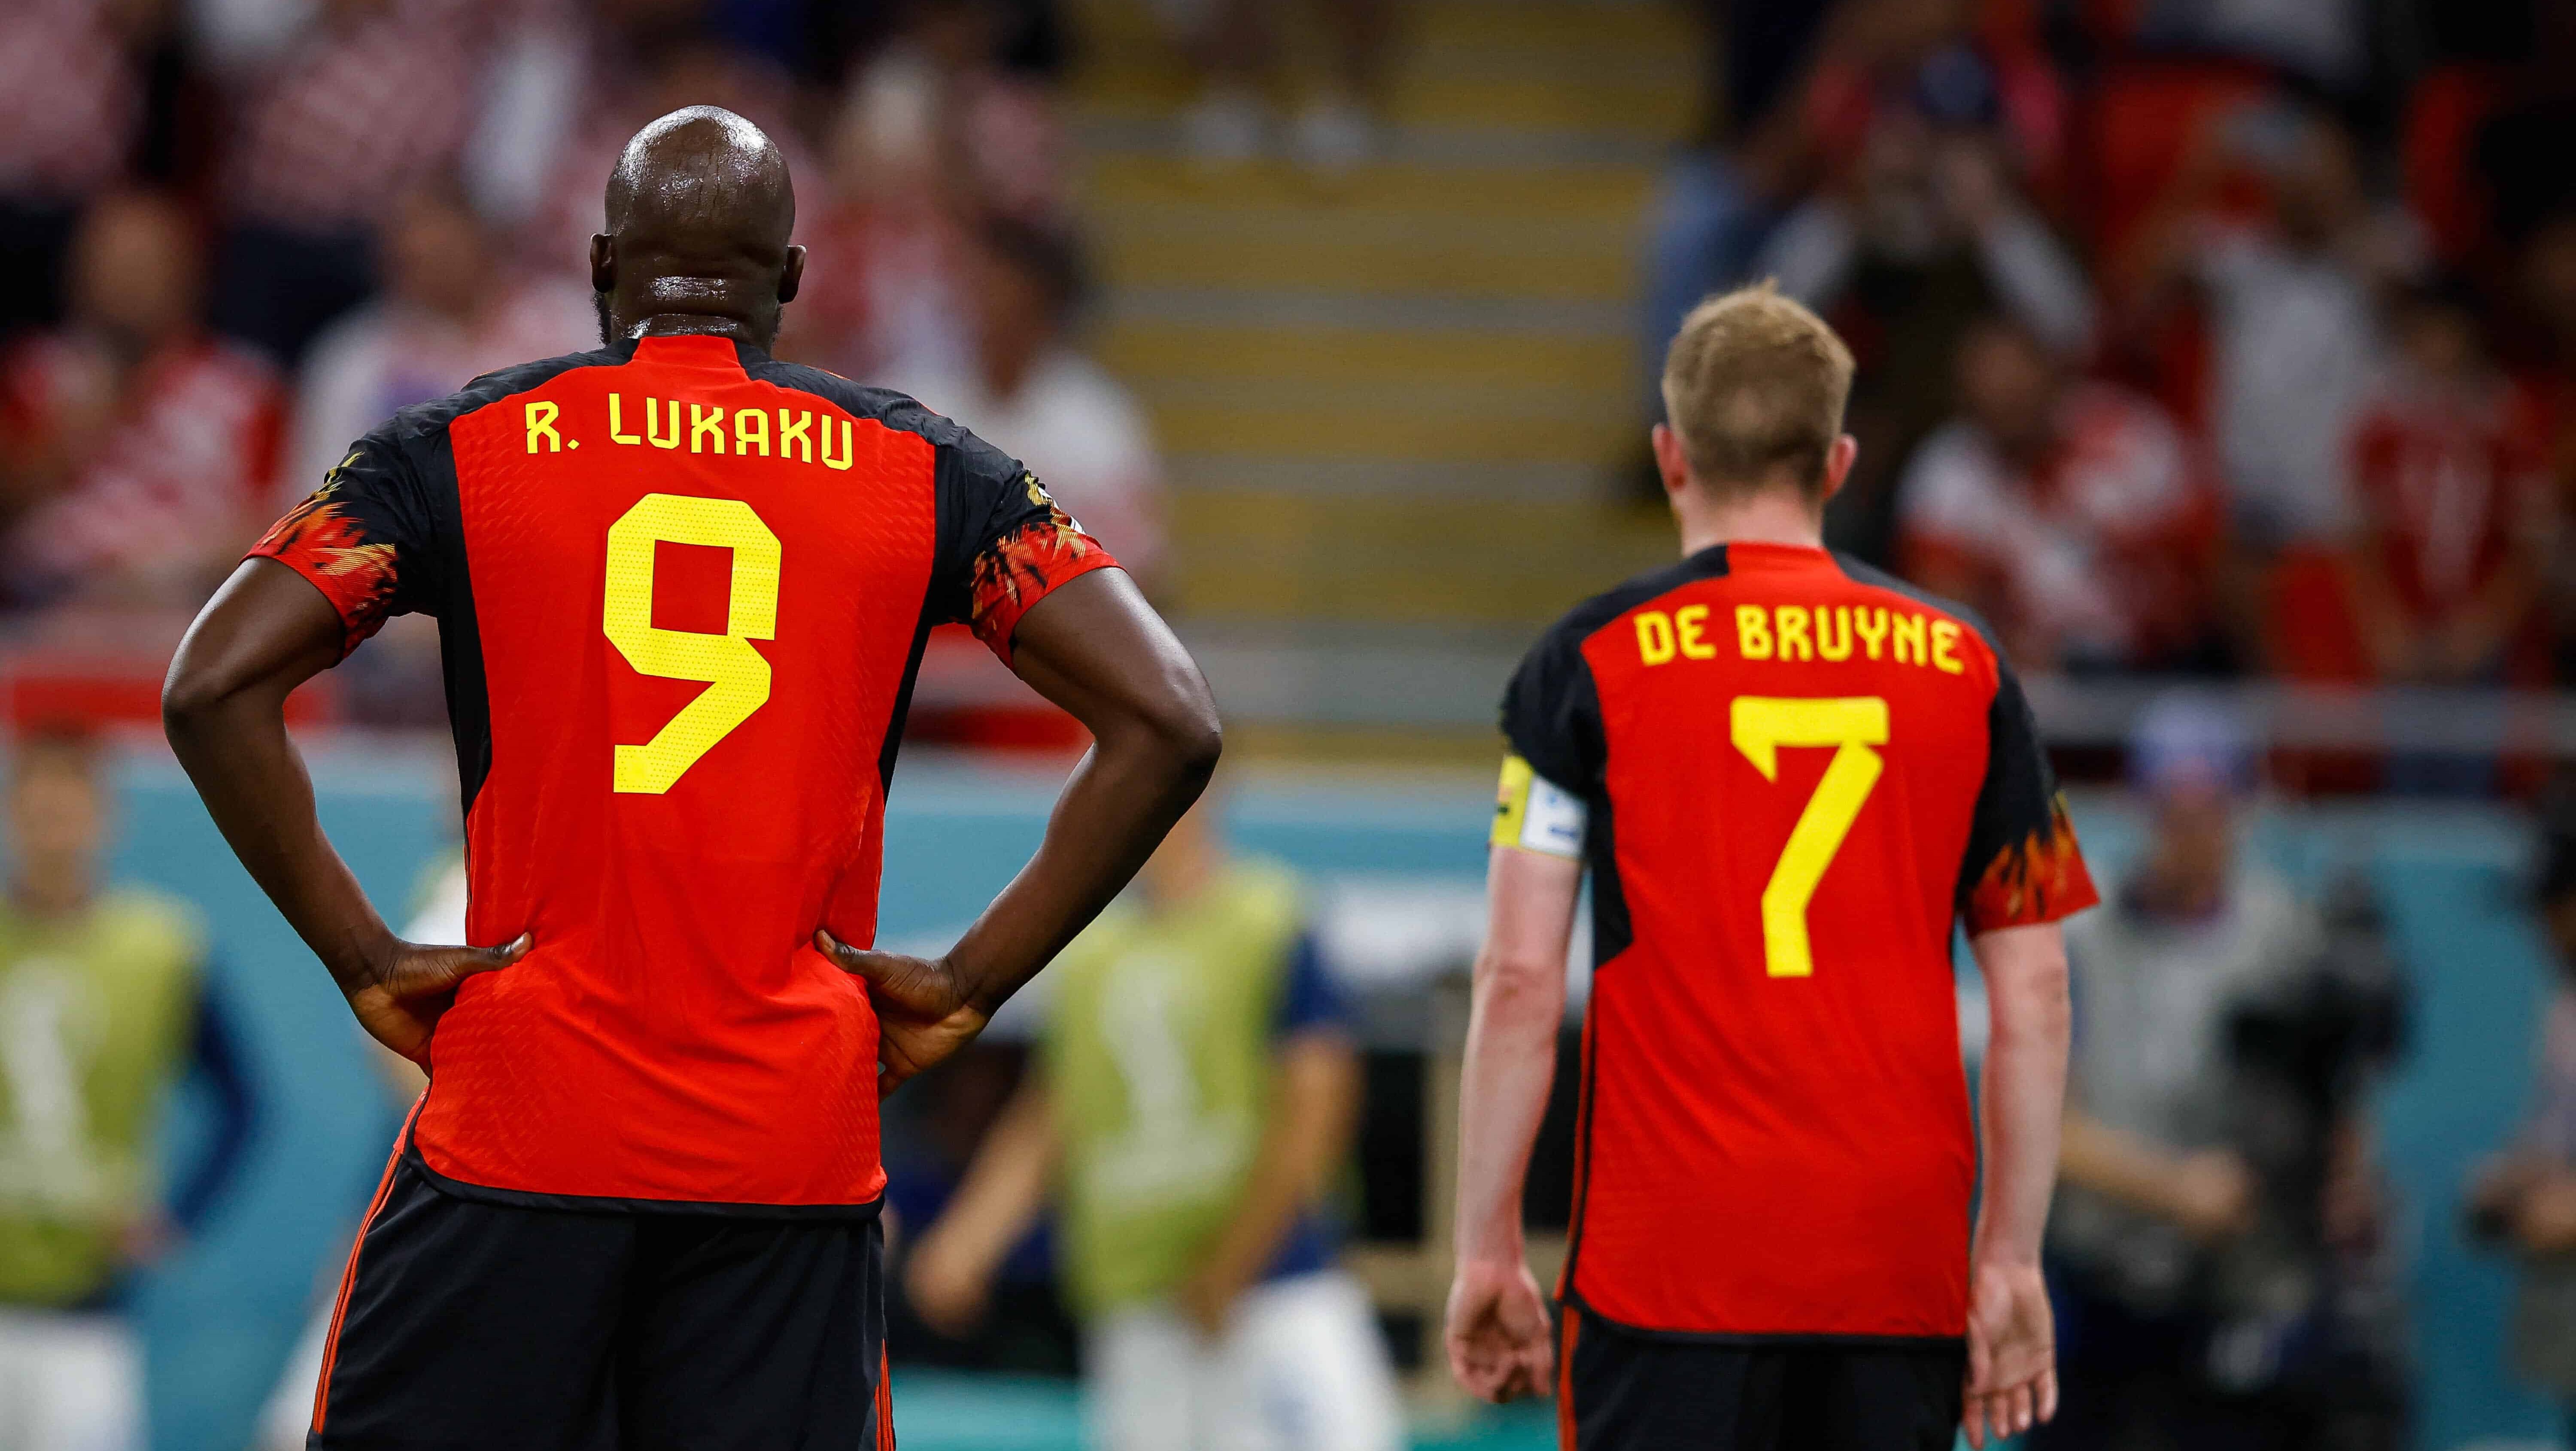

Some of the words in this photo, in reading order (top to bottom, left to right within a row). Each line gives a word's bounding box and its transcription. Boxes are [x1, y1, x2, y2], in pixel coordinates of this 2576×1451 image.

[525, 401, 580, 454] R.
[609, 393, 853, 471] LUKAKU
[603, 492, 782, 794] 9
[1634, 604, 1717, 666] DE
[1735, 604, 1964, 674] BRUYNE
[1730, 695, 1889, 977] 7
